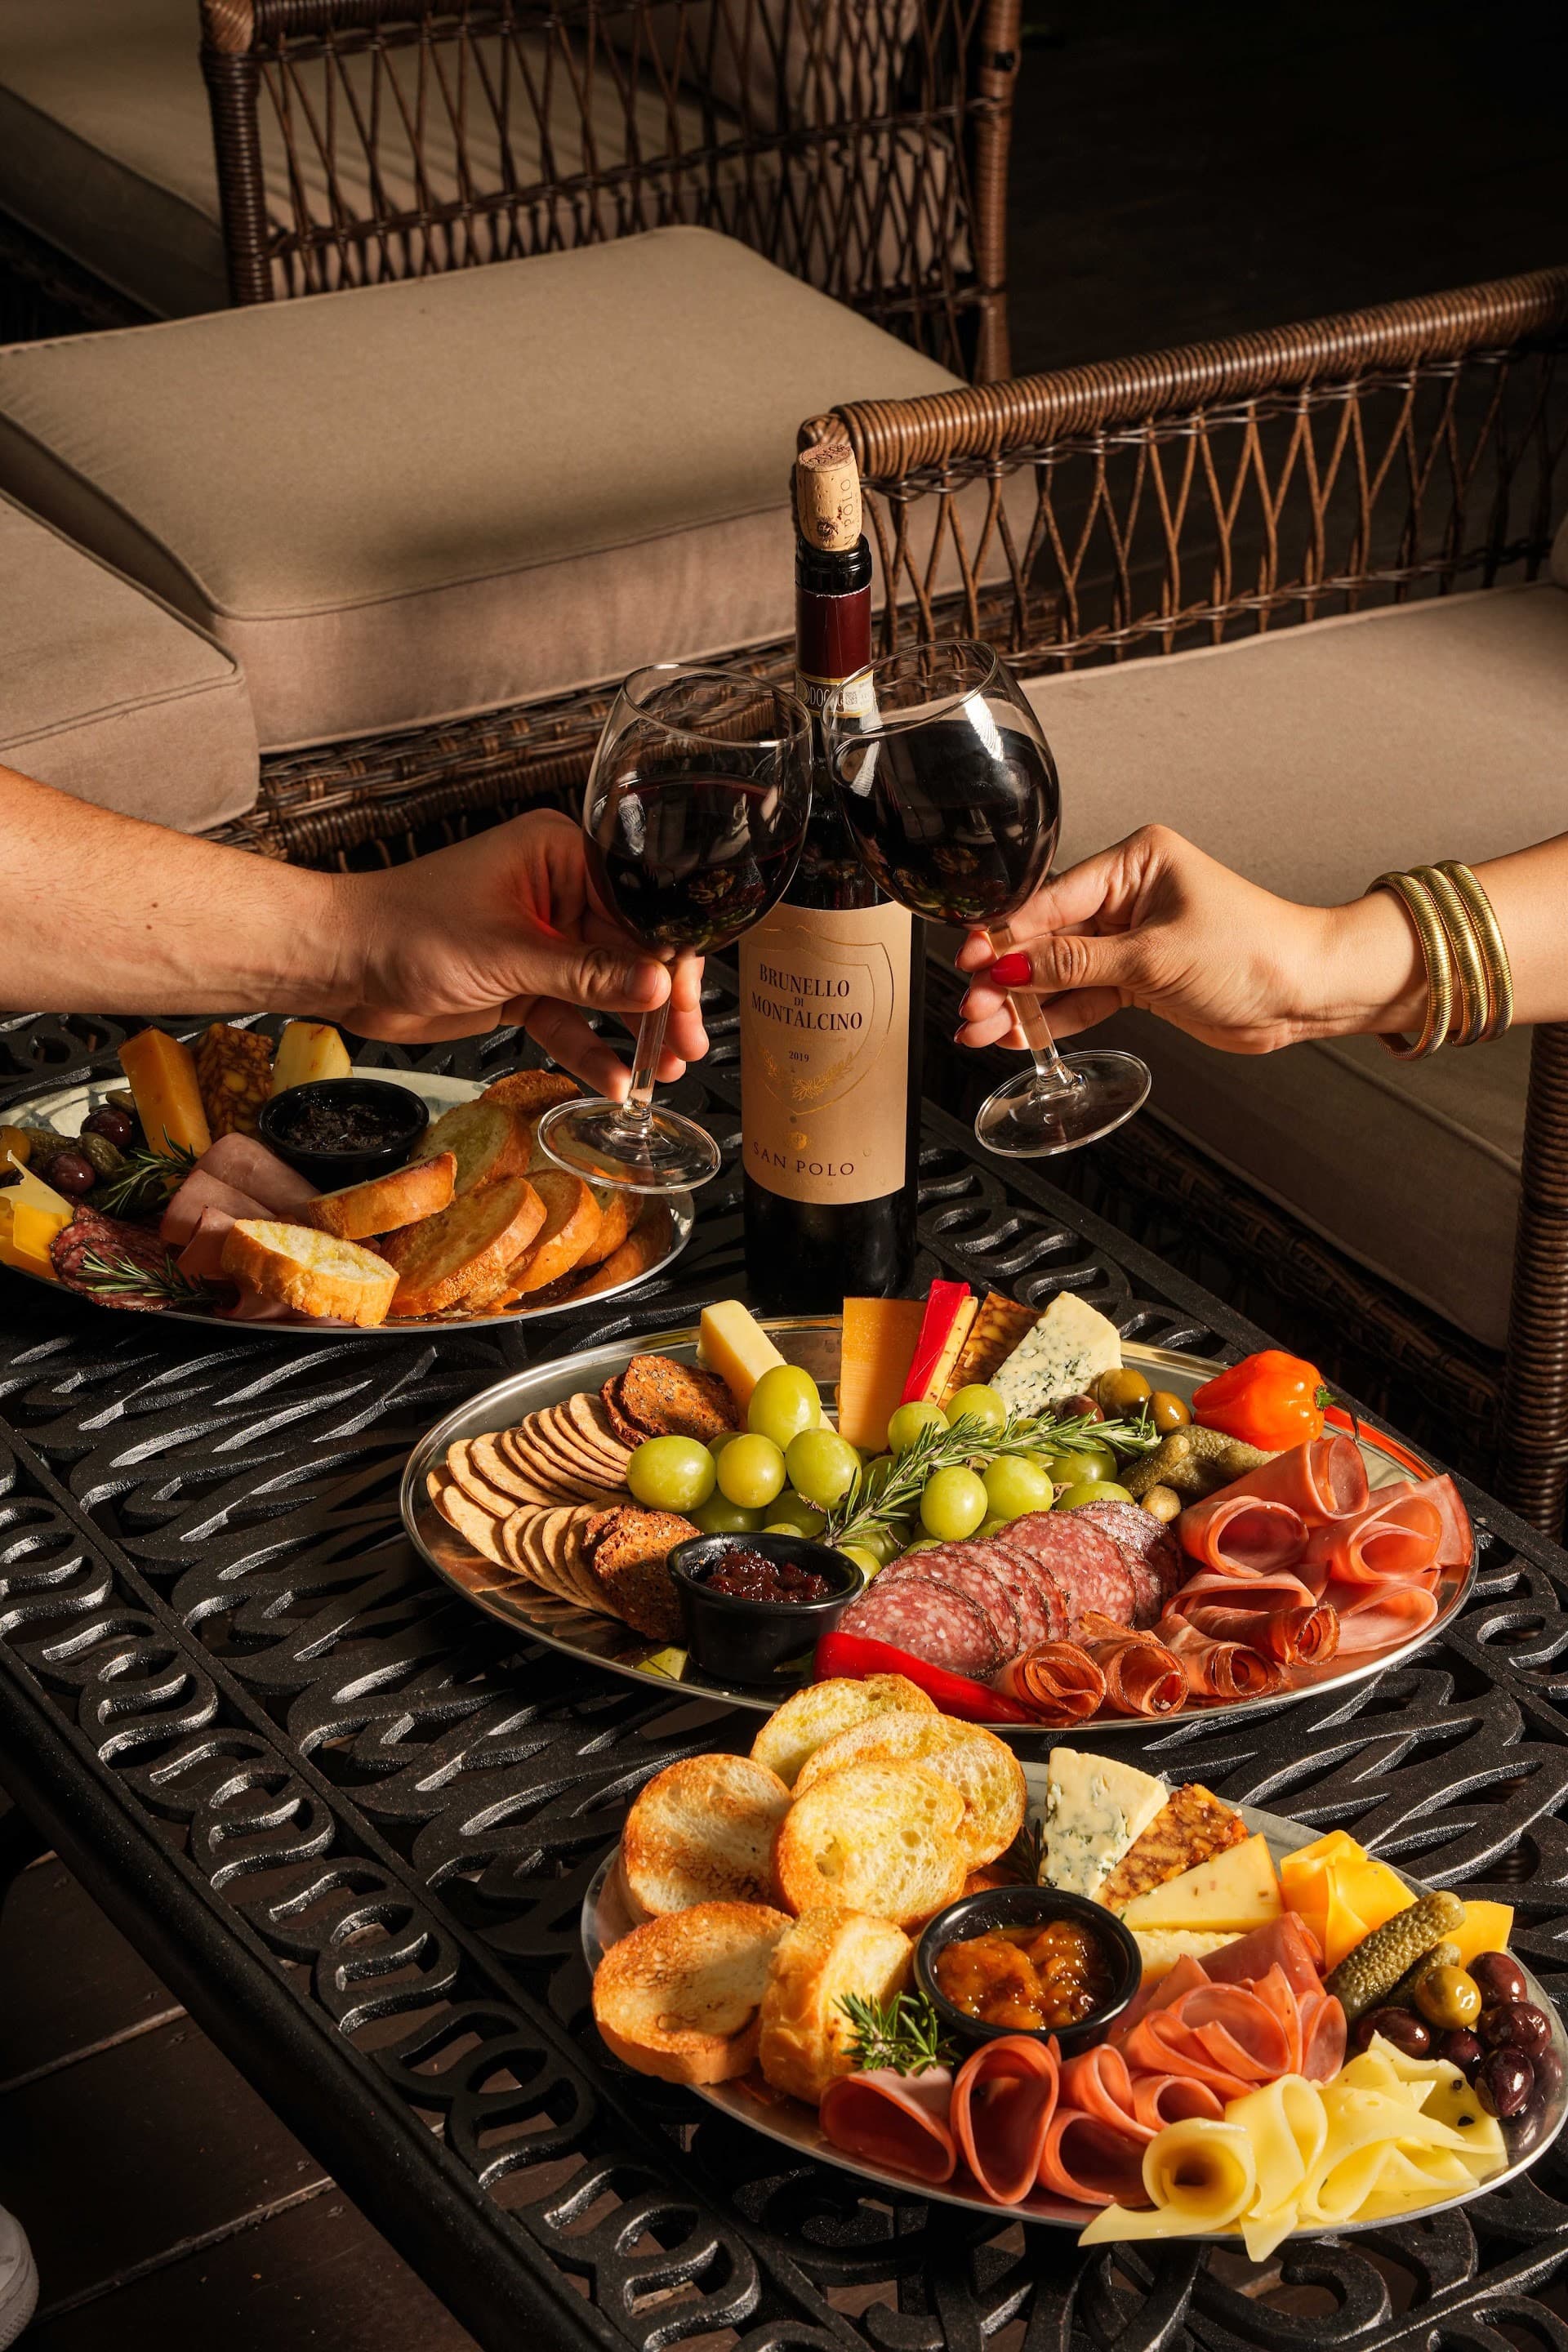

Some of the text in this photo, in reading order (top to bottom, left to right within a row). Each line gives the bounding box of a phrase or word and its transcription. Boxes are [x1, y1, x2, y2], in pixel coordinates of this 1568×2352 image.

[760, 963, 849, 997] BRUNELLO
[751, 991, 862, 1031] MONTALCINO
[794, 996, 804, 1007] DI
[789, 1050, 809, 1062] 2019
[753, 1141, 854, 1176] SAN POLO
